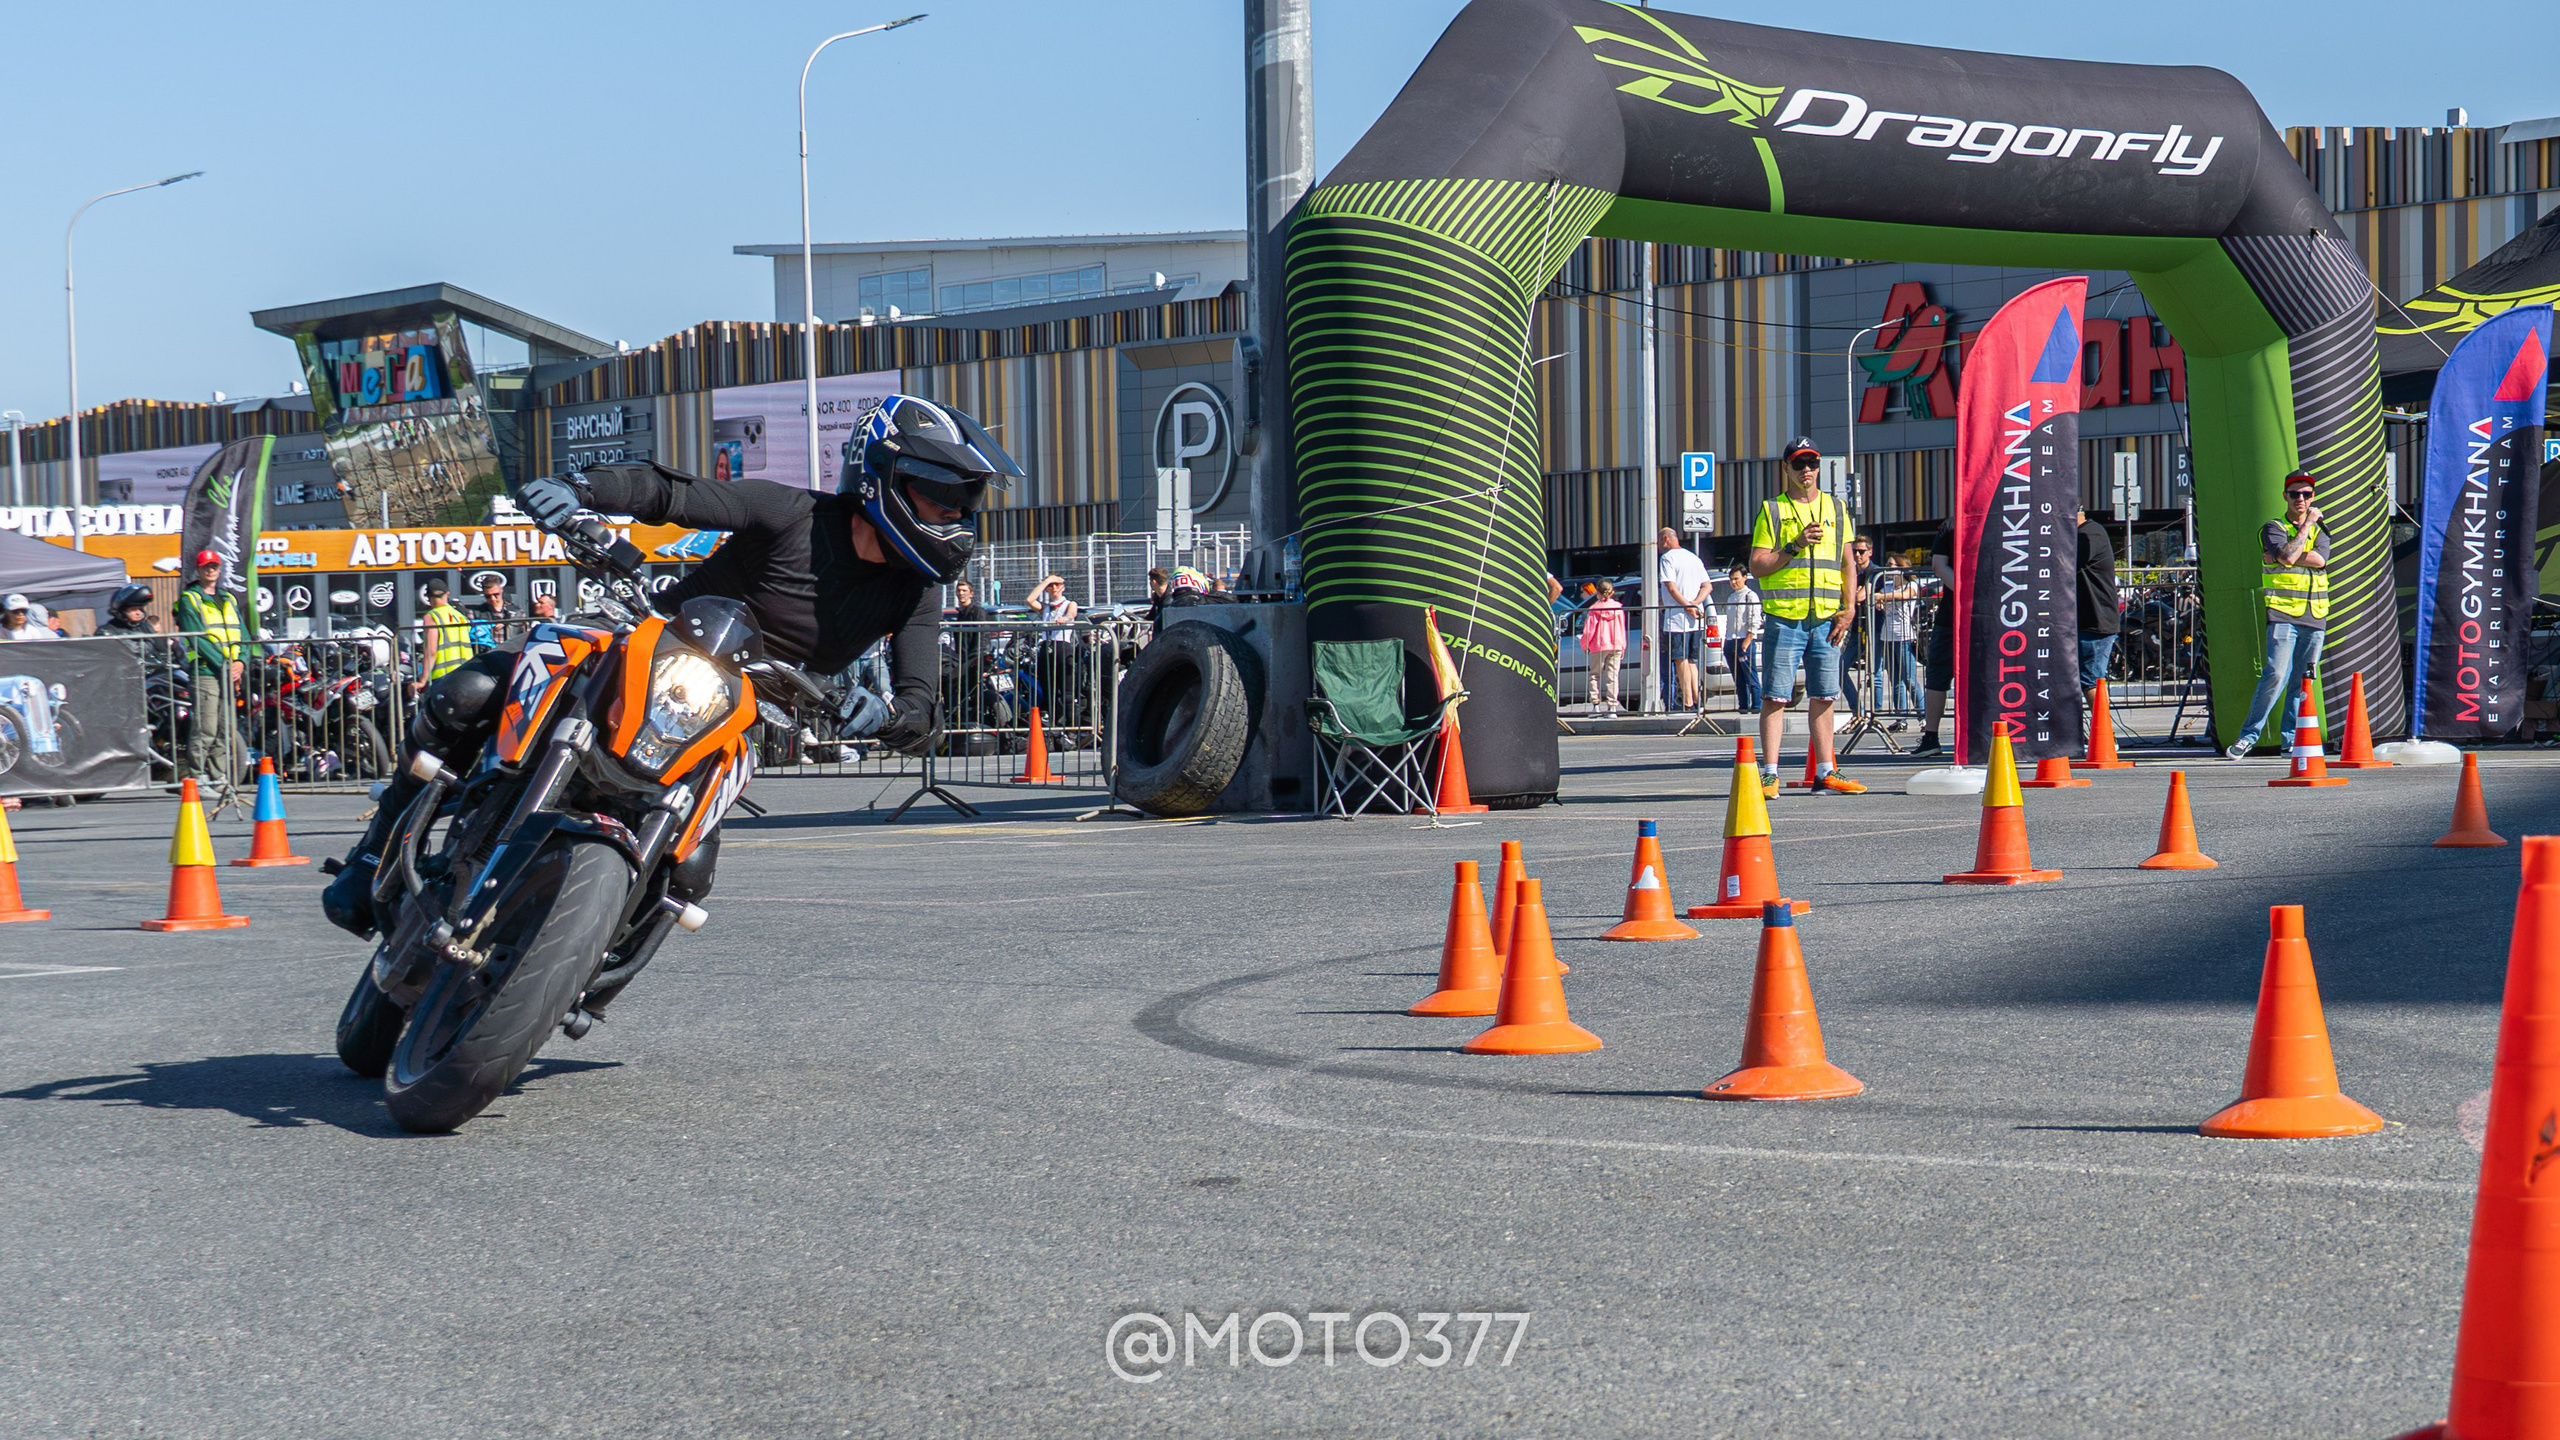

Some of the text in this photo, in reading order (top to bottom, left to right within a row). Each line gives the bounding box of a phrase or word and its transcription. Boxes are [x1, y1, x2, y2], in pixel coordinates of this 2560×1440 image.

[1774, 88, 2225, 177] Dragonfly
[567, 406, 624, 440] ВКУСНЫЙ
[801, 402, 835, 416] HNOR
[1174, 402, 1217, 468] P
[274, 483, 305, 506] LIME
[1690, 457, 1709, 487] P
[2176, 472, 2189, 487] 10
[349, 527, 631, 566] АВТОЗАПЧА
[1998, 400, 2032, 743] MOTOGYMKHANA
[2037, 399, 2054, 742] EKATERINBURG TEAM
[2455, 416, 2493, 722] MOTOGYMKHANA
[2488, 416, 2514, 723] EKATERINBURG TEAM
